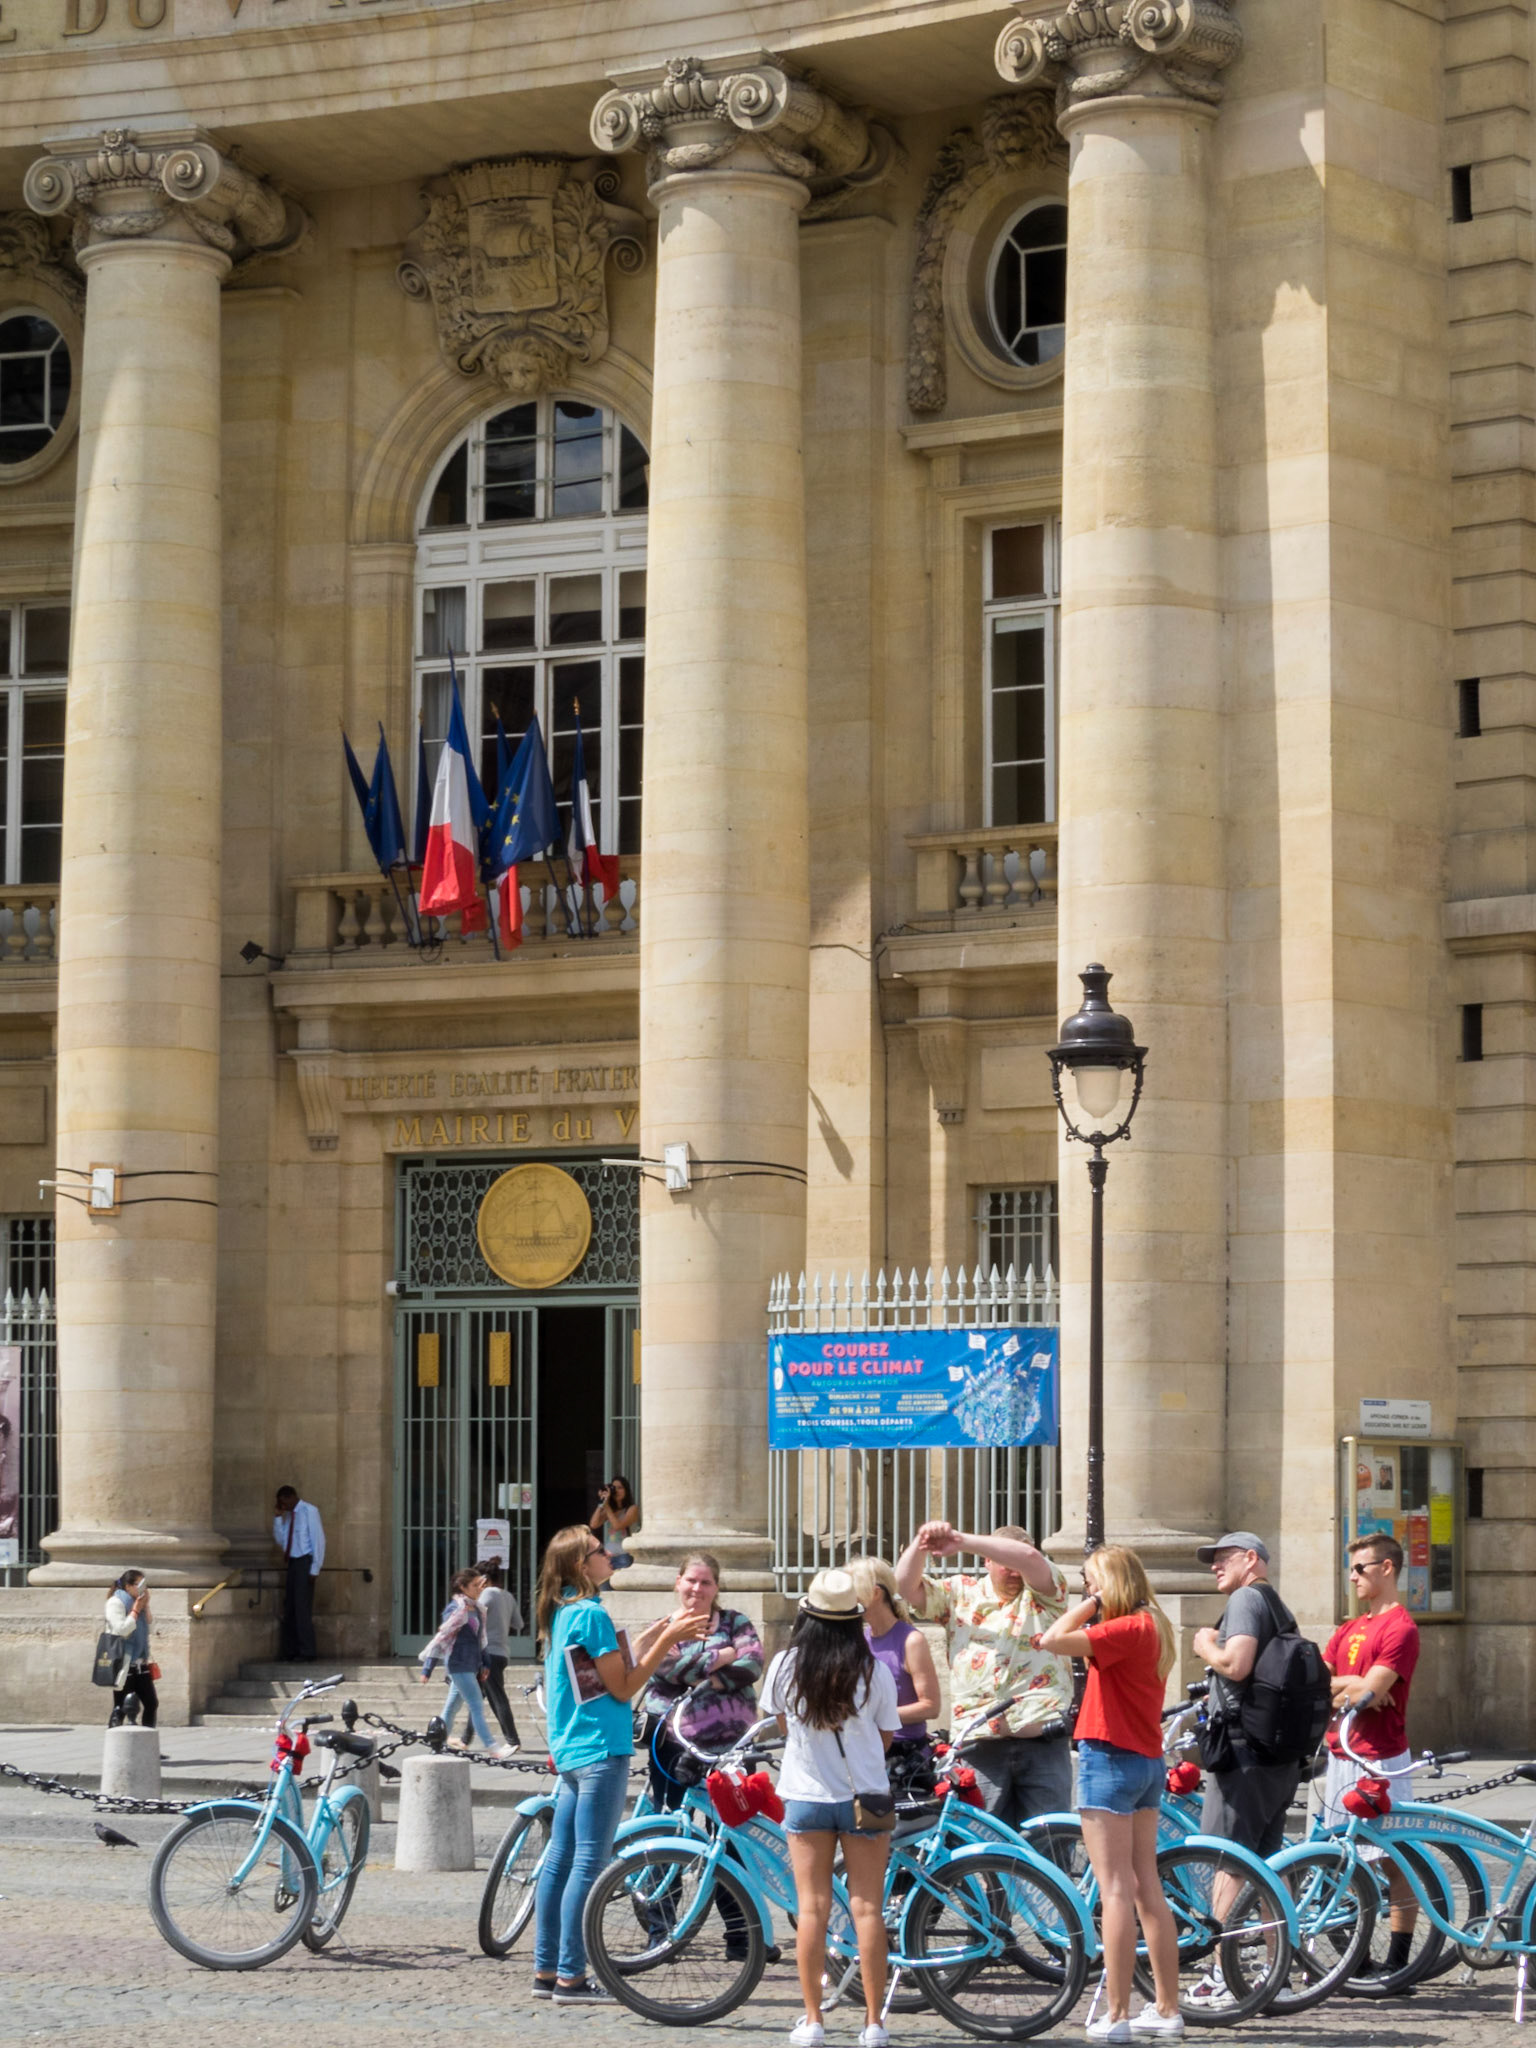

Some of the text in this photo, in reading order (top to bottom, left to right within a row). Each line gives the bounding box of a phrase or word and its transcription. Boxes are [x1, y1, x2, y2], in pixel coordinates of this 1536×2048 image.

[344, 1069, 436, 1101] LIBERTÉ
[553, 1064, 639, 1093] FRATER
[392, 1112, 533, 1147] MAIRIE
[552, 1110, 594, 1140] du
[822, 1342, 890, 1359] COUREZ
[788, 1359, 925, 1377] POUR LE CLIMAT
[828, 1393, 860, 1401] DIMANCHE
[829, 1406, 840, 1414] DE
[797, 1419, 819, 1427] TROIS
[857, 1418, 879, 1426] TROIS
[880, 1416, 913, 1426] DÉPARTS
[1381, 1815, 1501, 1846] BLUE BIKE TOURS
[748, 1825, 785, 1855] BLUE
